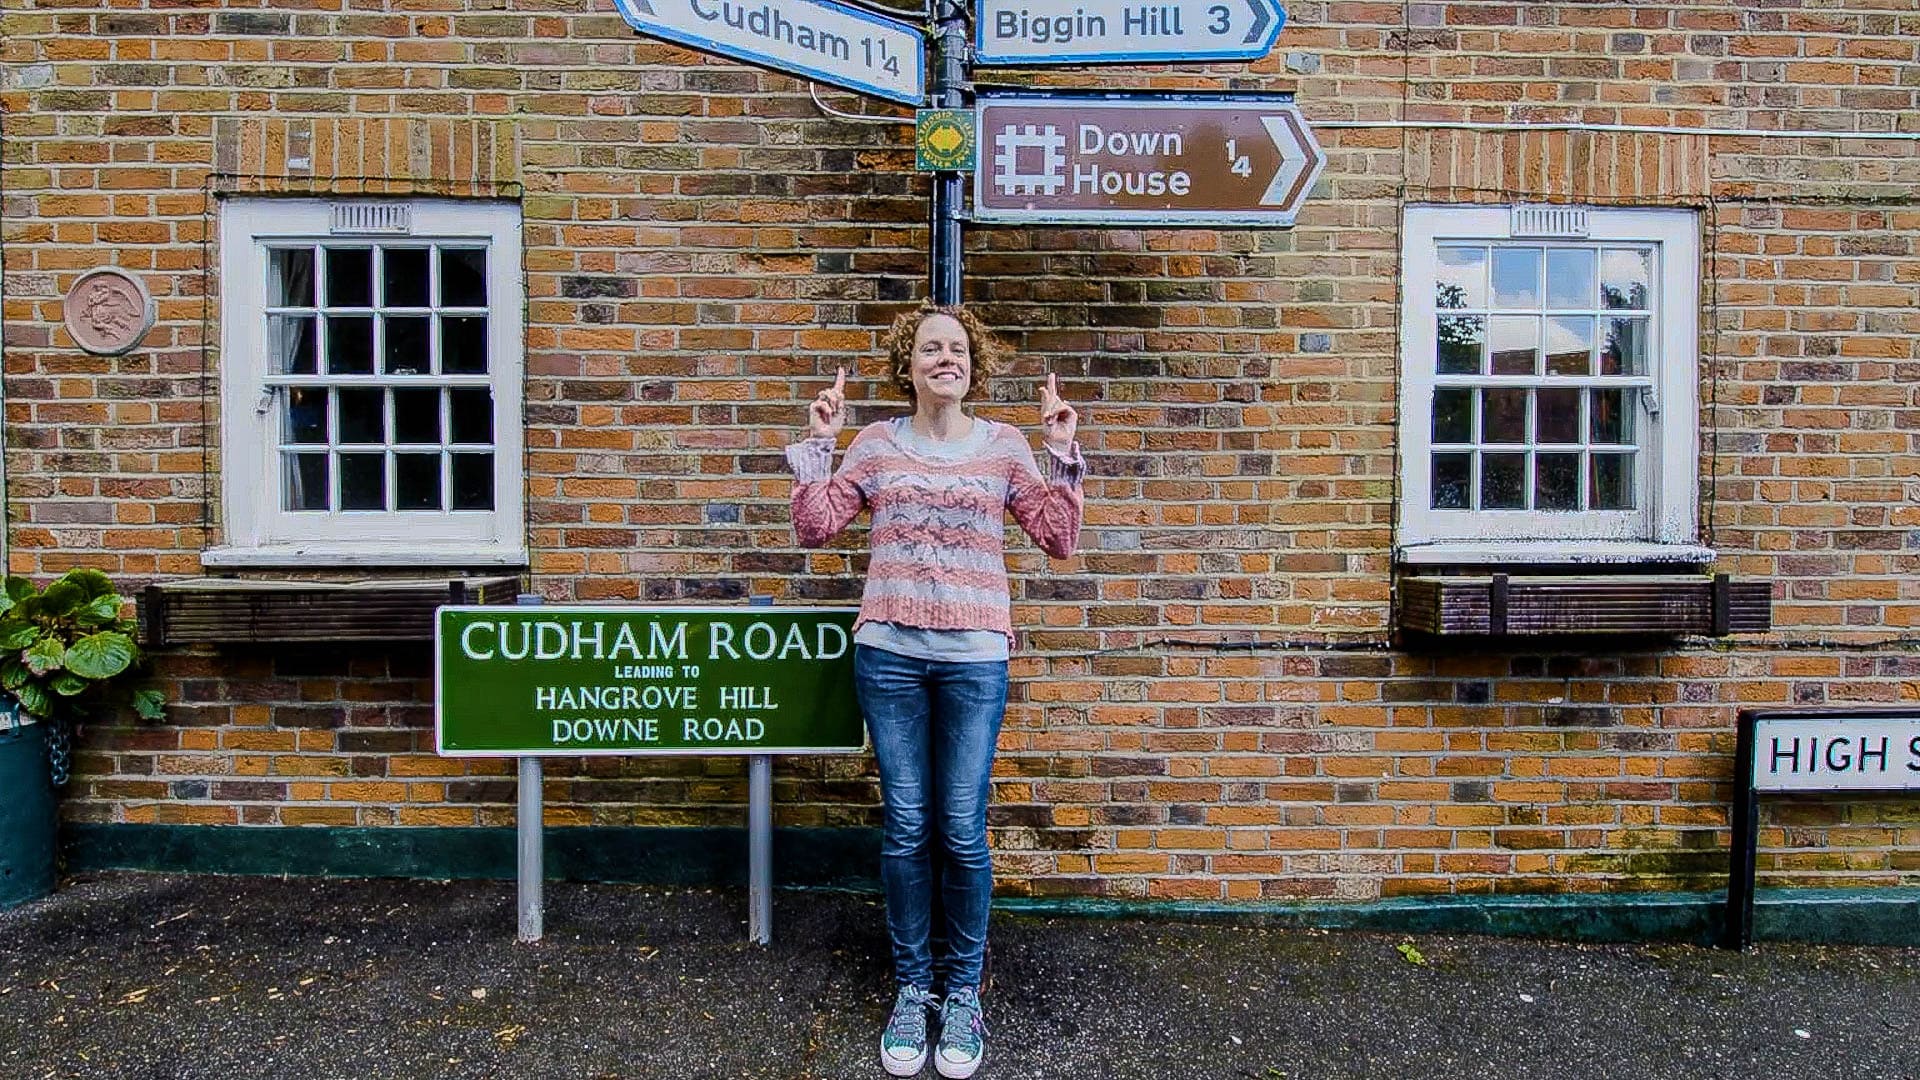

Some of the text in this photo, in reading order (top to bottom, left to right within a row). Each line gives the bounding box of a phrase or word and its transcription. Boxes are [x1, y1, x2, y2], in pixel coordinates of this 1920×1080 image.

[690, 0, 850, 61] Cudham
[995, 5, 1231, 44] Biggin Hill 3
[1079, 124, 1183, 156] Down
[1073, 164, 1191, 196] House
[460, 620, 849, 661] CUDHAM ROAD
[614, 665, 700, 679] LEADING TO
[535, 686, 779, 711] HANGROVE HILL
[552, 718, 765, 743] DOWNE ROAD
[1769, 736, 1889, 773] HIGH
